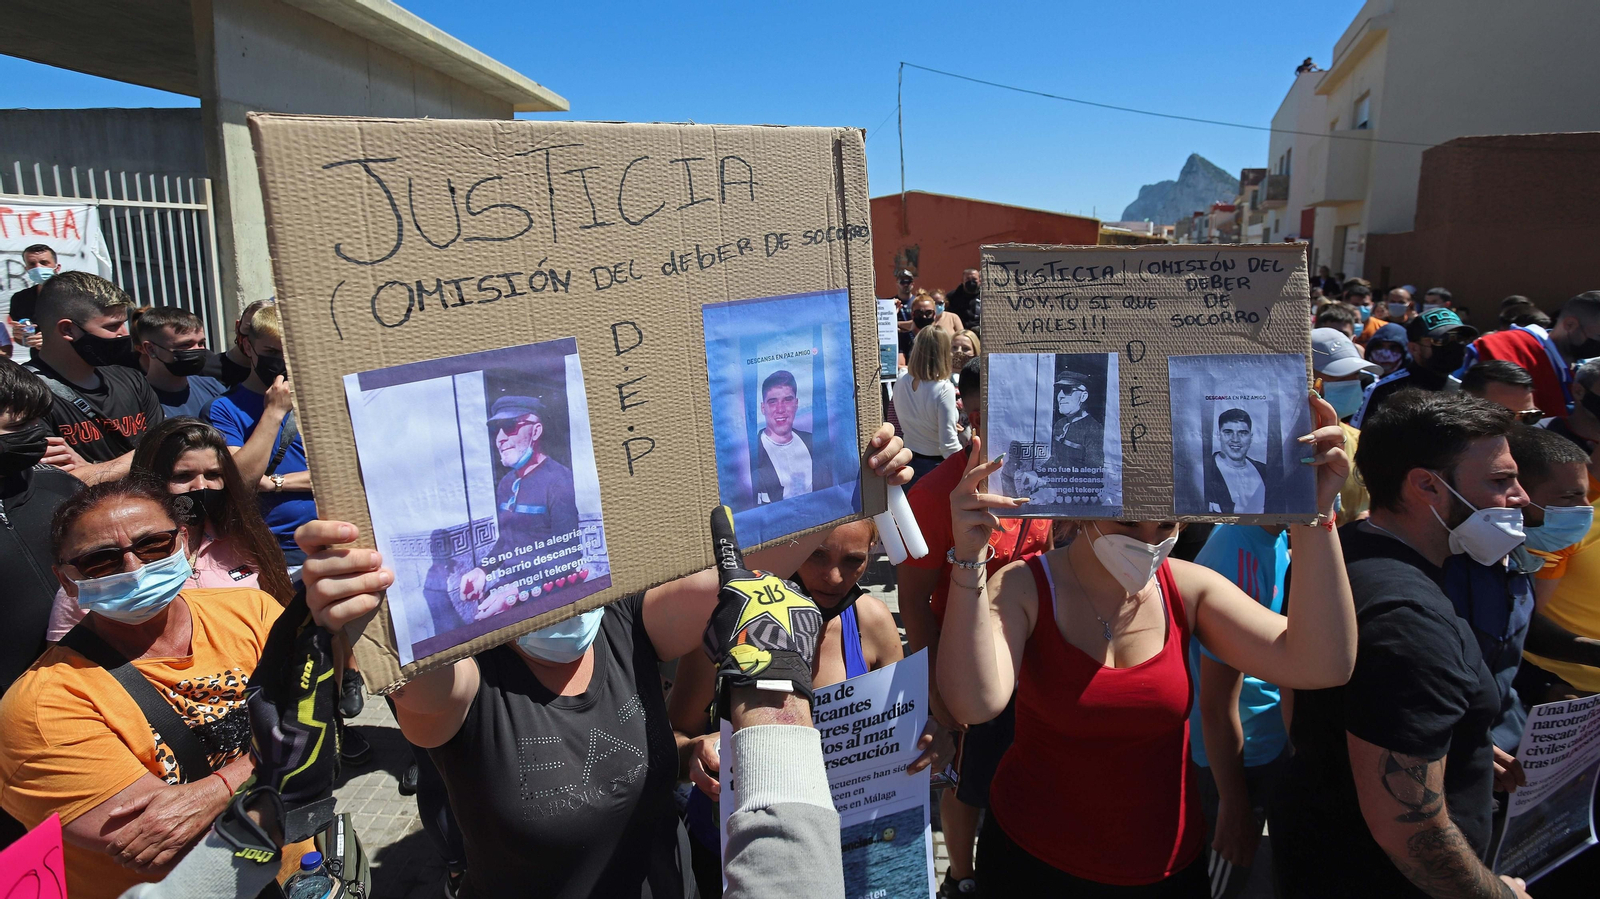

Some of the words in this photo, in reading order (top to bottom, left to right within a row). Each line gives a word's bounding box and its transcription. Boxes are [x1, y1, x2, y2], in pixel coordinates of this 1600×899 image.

[321, 143, 764, 266] JUSTICIA
[589, 259, 643, 291] DEL
[763, 231, 791, 258] DE
[1247, 256, 1285, 274] DEL
[1185, 273, 1251, 293] DEBER
[1088, 296, 1113, 310] SI
[1122, 295, 1158, 311] QUE
[1202, 292, 1231, 309] DE
[746, 355, 776, 366] DESCANSA
[775, 353, 785, 361] EN
[783, 351, 795, 360] PAZ
[794, 349, 811, 357] AMIGO
[1058, 465, 1071, 473] fue
[1072, 465, 1079, 473] la
[481, 554, 497, 567] Se
[498, 552, 514, 564] no
[514, 545, 534, 558] fue
[534, 539, 545, 550] la
[584, 523, 598, 535] de
[485, 571, 495, 582] el
[497, 560, 532, 579] barrio
[533, 543, 584, 567] descansa
[585, 538, 598, 549] en
[514, 572, 543, 591] angel
[834, 683, 855, 701] de
[820, 722, 850, 740] tres
[851, 699, 916, 735] guardias
[1537, 705, 1565, 717] Una
[846, 733, 861, 750] al
[863, 725, 896, 746] mar
[1525, 743, 1567, 756] civiles
[1523, 759, 1549, 769] tras
[873, 769, 891, 780] han
[849, 801, 862, 810] en
[863, 789, 897, 806] Málaga
[852, 786, 865, 797] en
